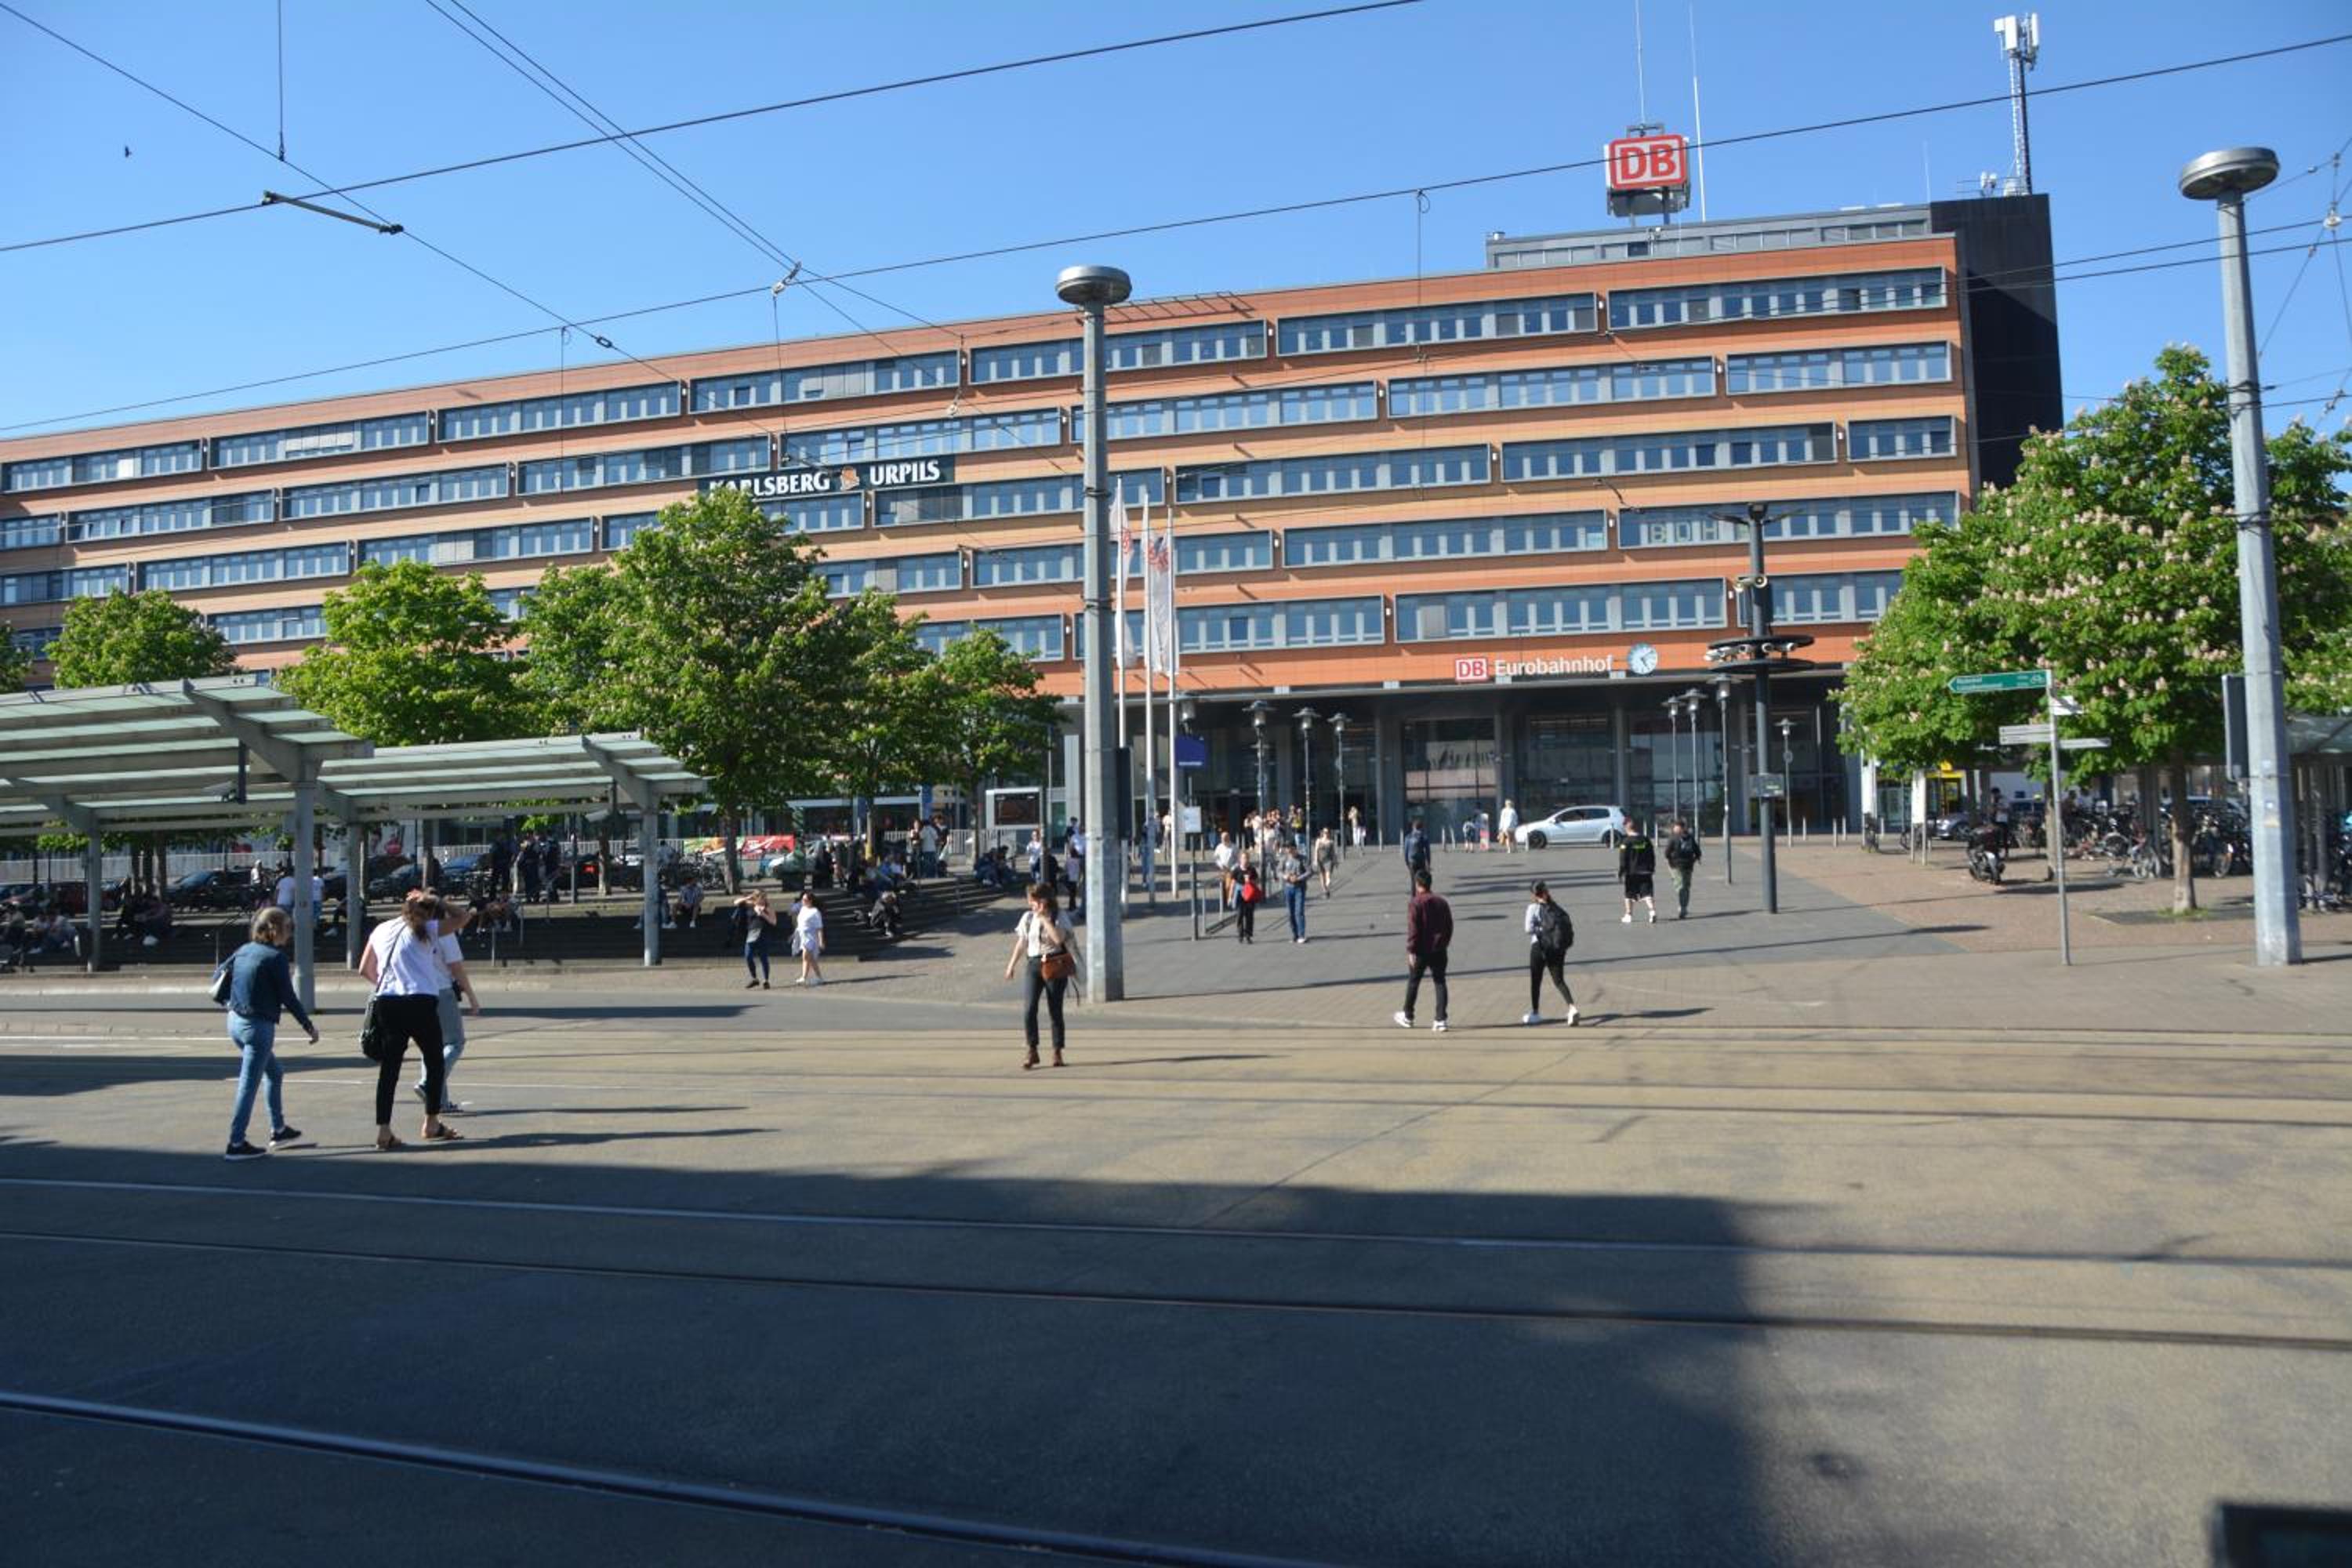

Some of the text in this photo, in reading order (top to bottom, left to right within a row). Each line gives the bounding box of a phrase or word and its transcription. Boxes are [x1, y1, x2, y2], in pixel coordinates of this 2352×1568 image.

[1621, 144, 1676, 180] DB
[869, 459, 941, 486] URPILS
[1459, 655, 1613, 678] DB Eurobahnhof
